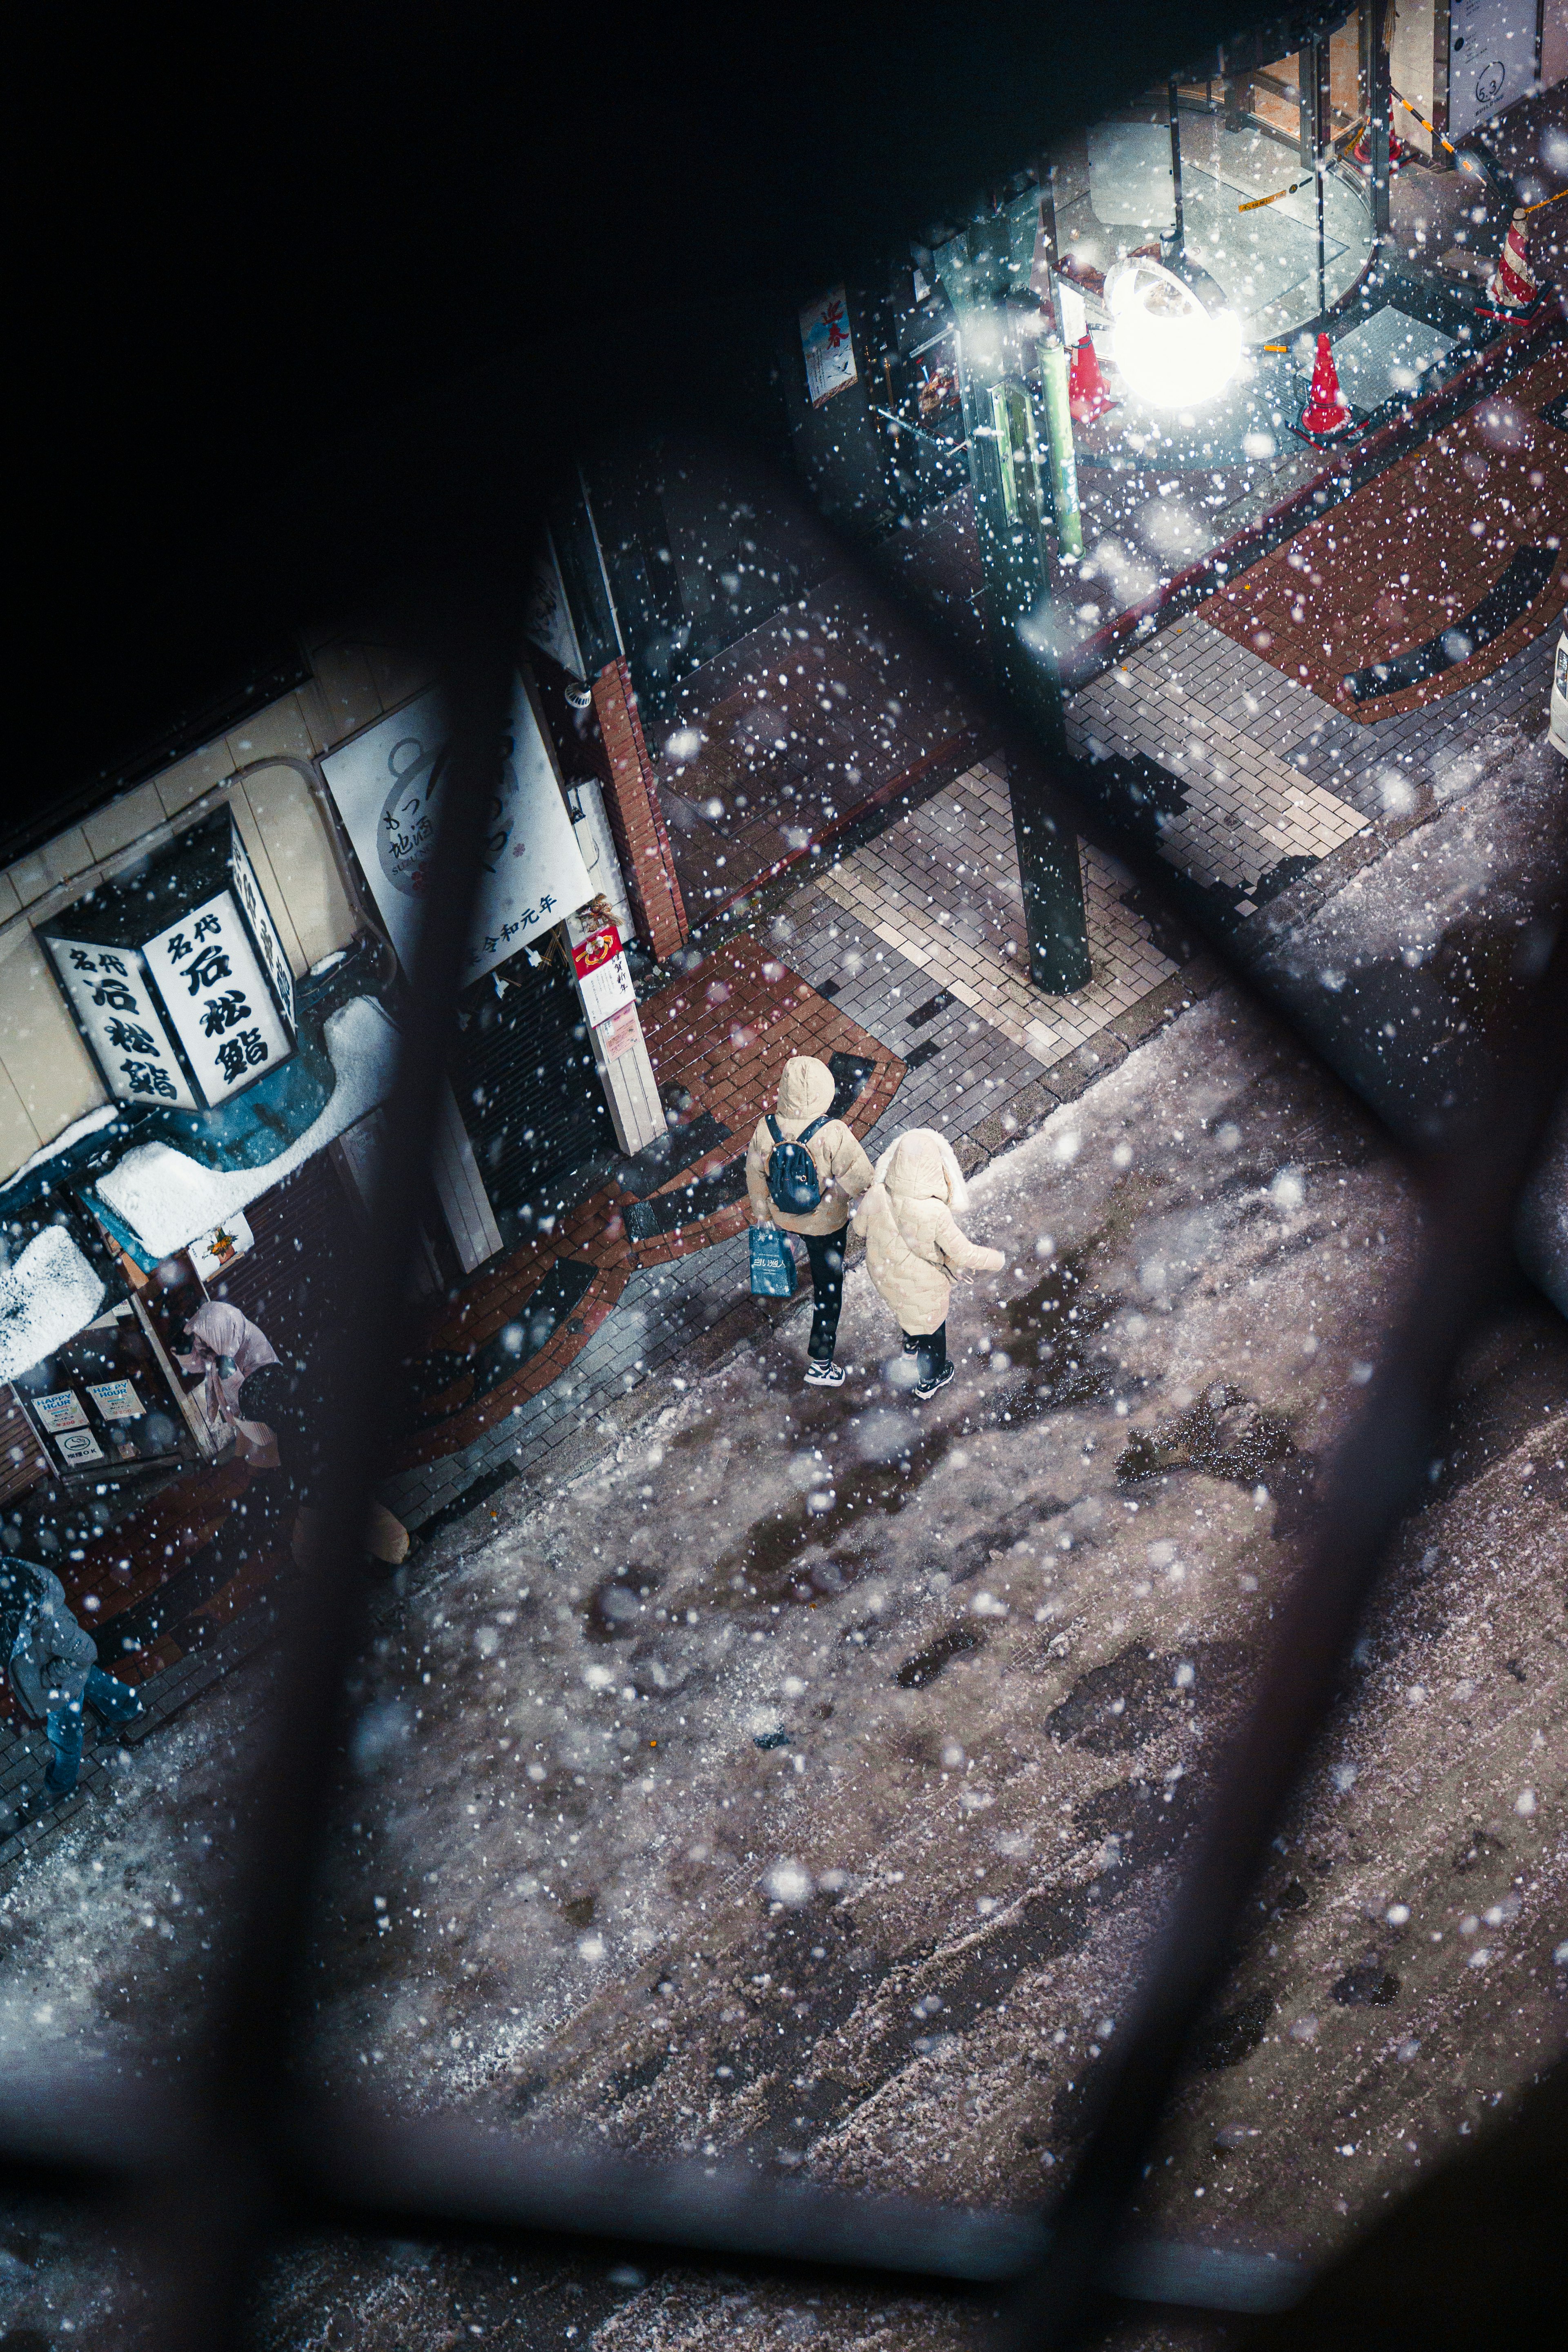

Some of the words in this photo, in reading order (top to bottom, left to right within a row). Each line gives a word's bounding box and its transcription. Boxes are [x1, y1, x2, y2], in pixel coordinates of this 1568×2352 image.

[1479, 80, 1497, 101] 5.3
[821, 300, 850, 350] 迎春
[389, 815, 433, 858] 地酒
[167, 914, 221, 964] 名代
[69, 949, 127, 977] 名代
[180, 945, 269, 1085] 石松鮨
[37, 1394, 71, 1406] HAPPY
[99, 1389, 127, 1398] HOUR
